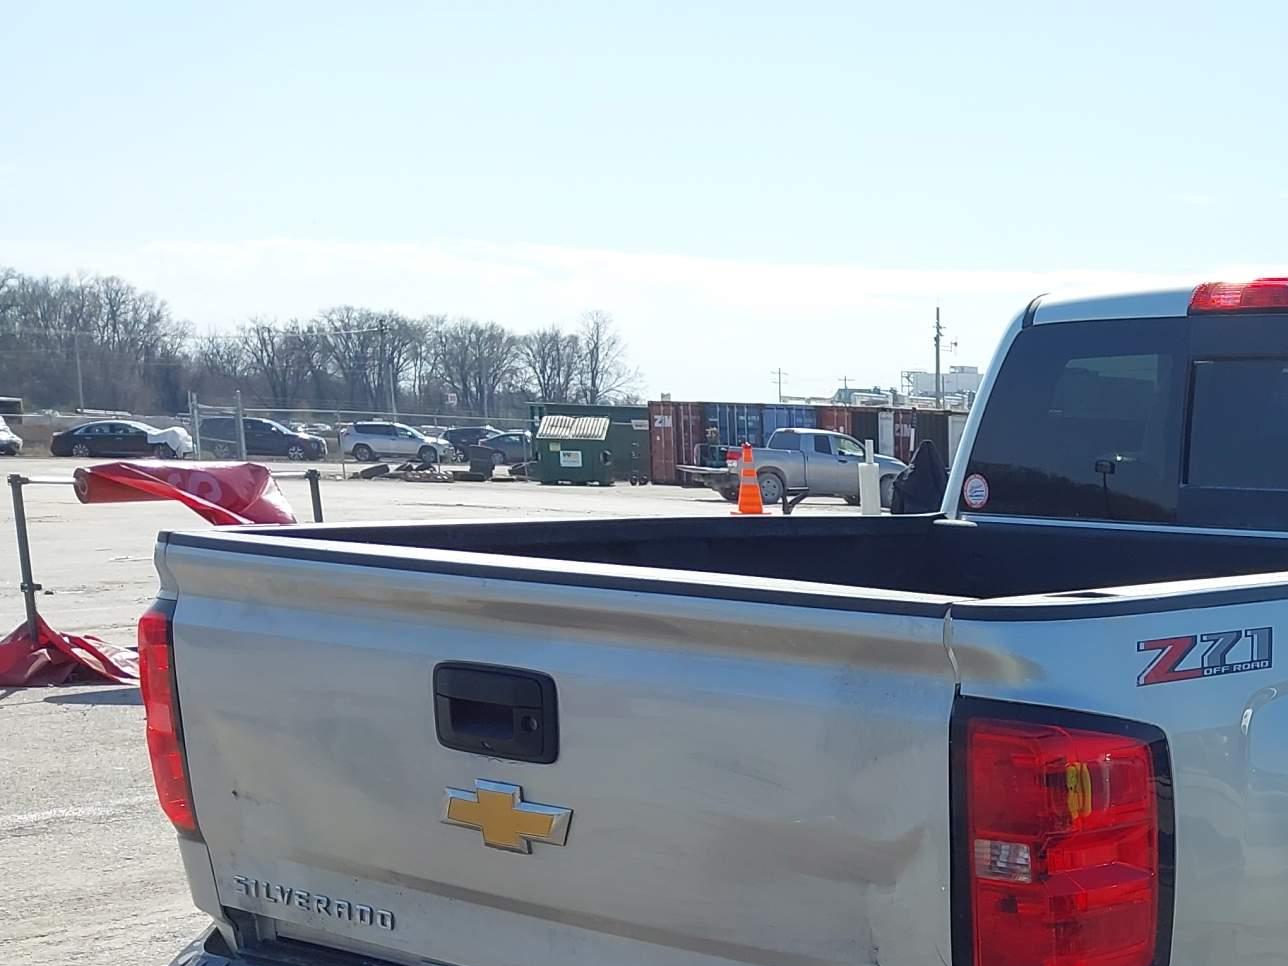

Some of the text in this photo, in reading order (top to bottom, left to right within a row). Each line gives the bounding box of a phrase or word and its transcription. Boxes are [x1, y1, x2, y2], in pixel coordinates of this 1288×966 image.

[1136, 627, 1273, 688] Z71
[1203, 661, 1270, 676] OFF ROAD
[232, 874, 396, 931] SILVERADO
